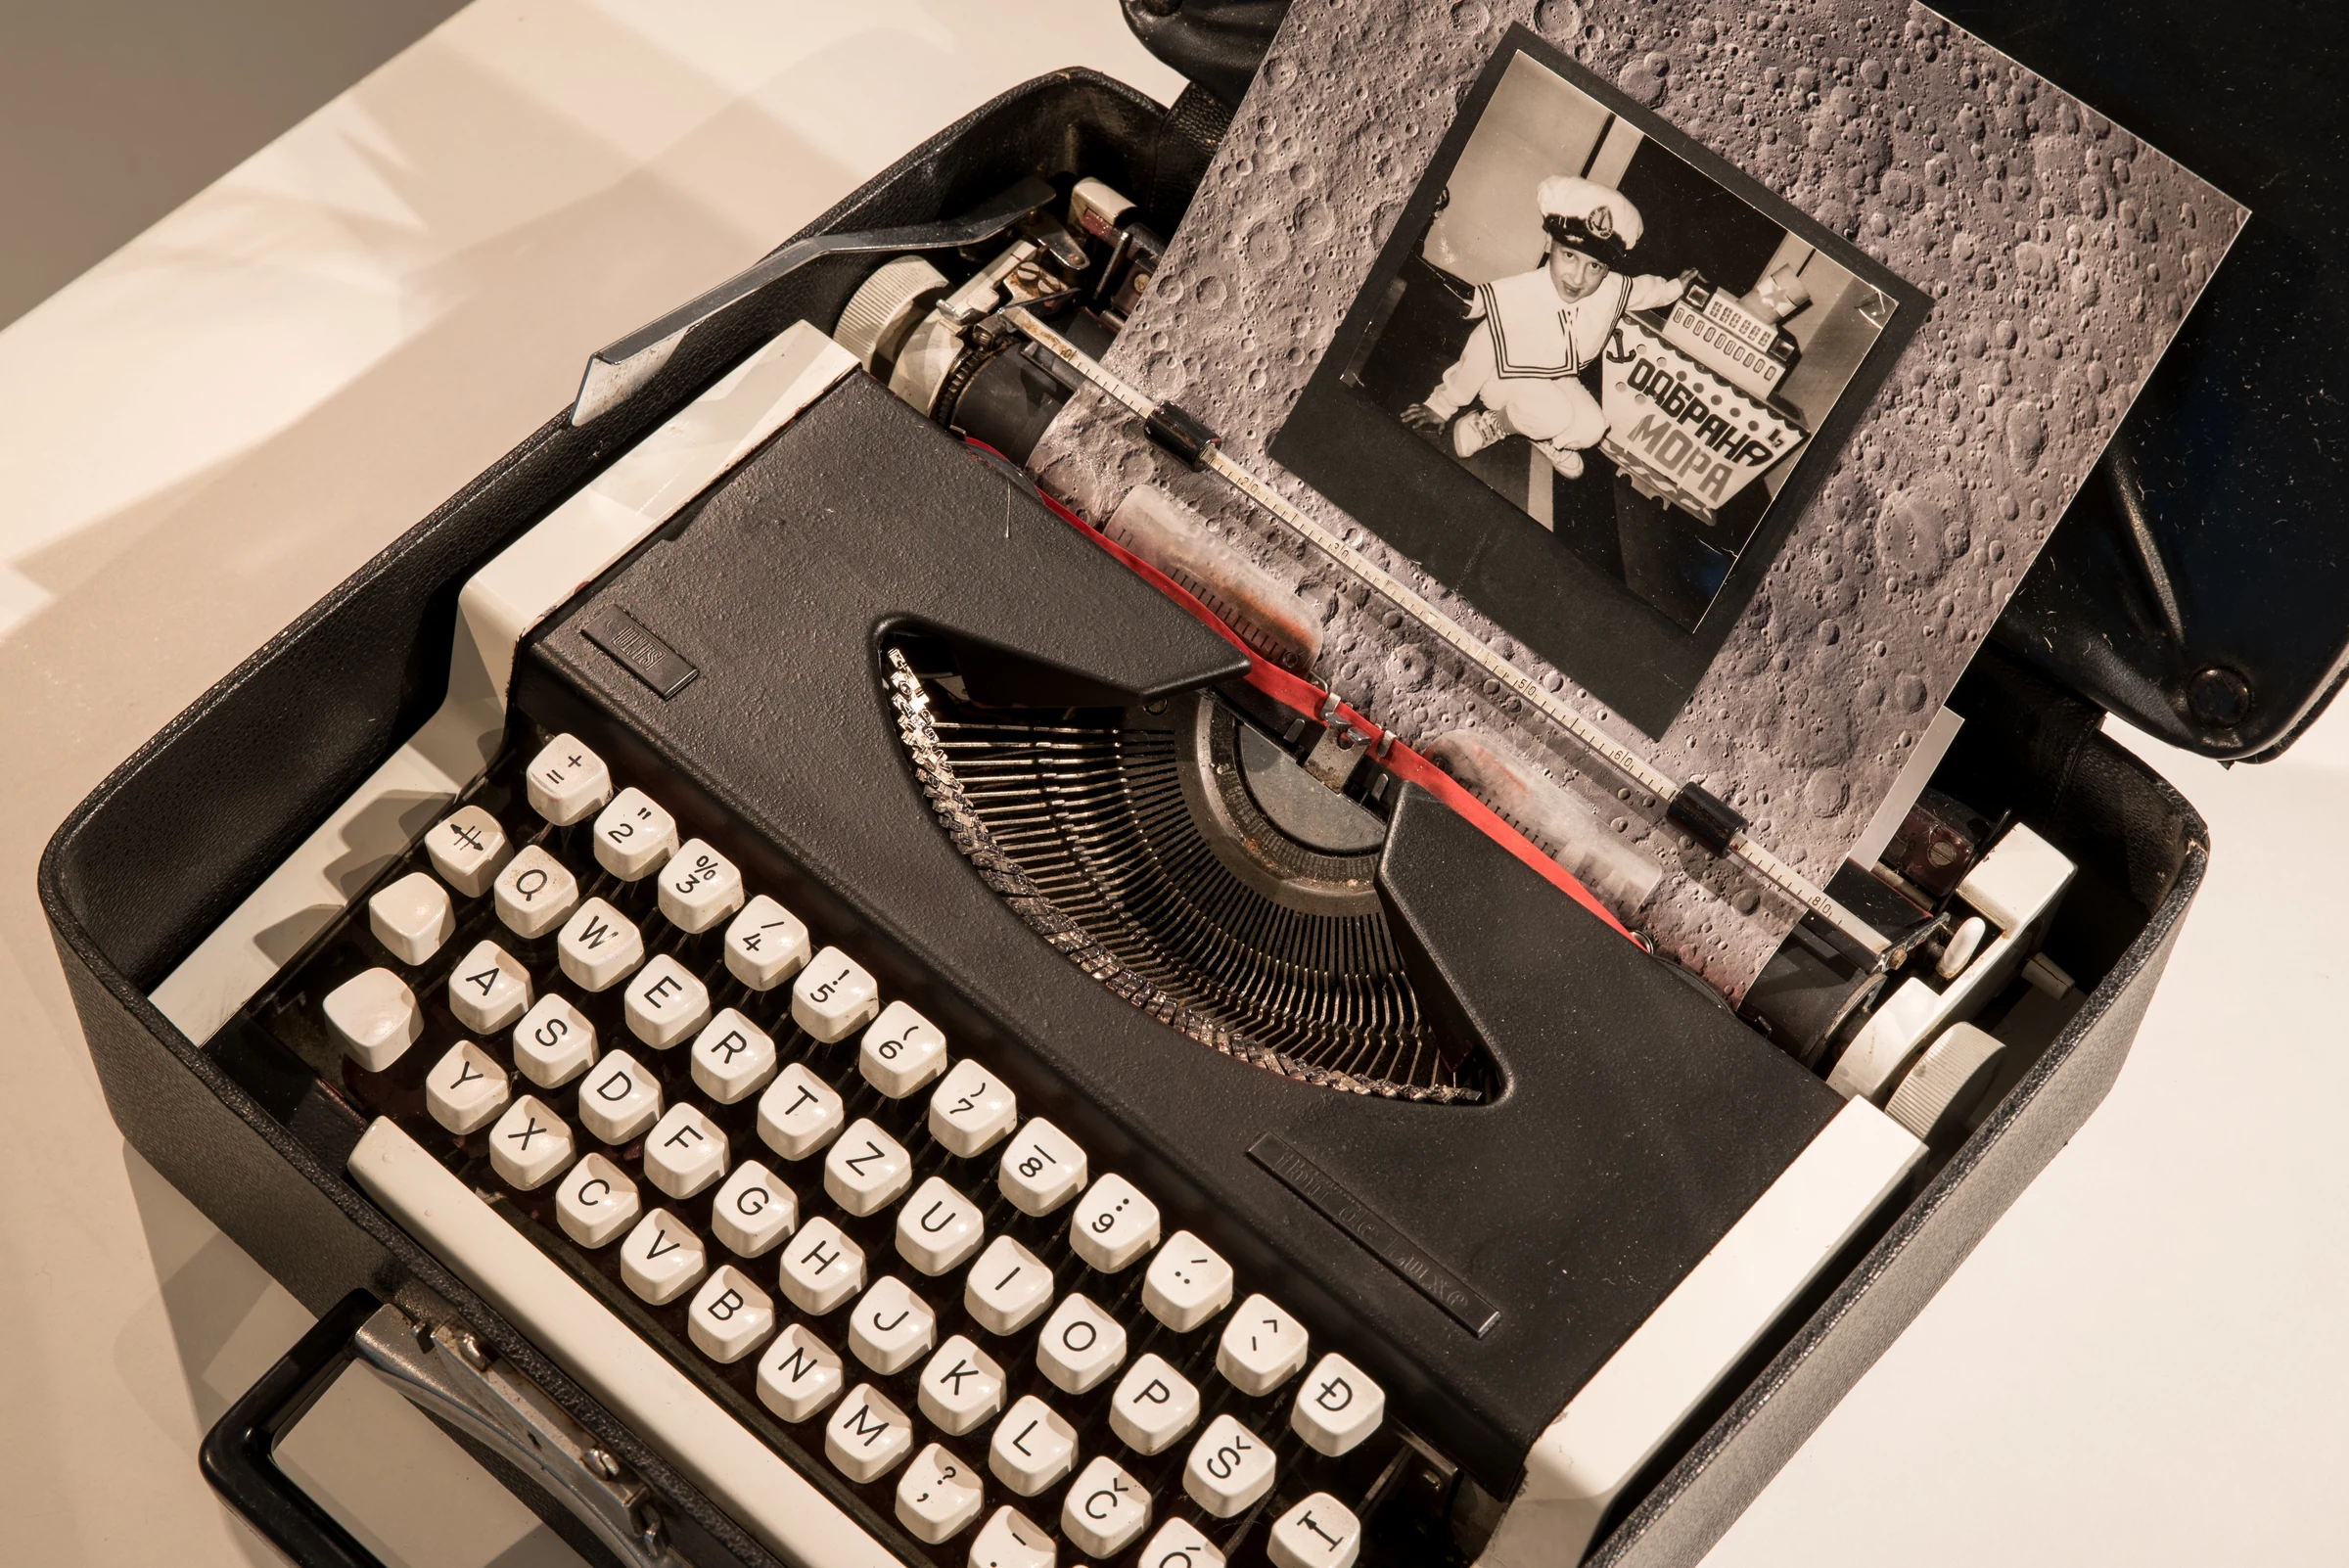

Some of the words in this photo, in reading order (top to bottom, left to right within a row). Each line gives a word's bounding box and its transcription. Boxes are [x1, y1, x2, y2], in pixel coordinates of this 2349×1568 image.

[1627, 357, 1774, 467] ОДБРАНА
[1627, 413, 1734, 503] МОРА
[1517, 678, 1537, 696] 50
[1613, 750, 1634, 766] 60
[1812, 896, 1832, 914] 80
[516, 868, 548, 902] Q
[578, 915, 619, 950] W
[742, 933, 761, 951] 4
[465, 967, 500, 996] A
[643, 975, 683, 1009] E
[809, 983, 836, 1003] 5
[534, 1018, 568, 1047] S
[712, 1030, 747, 1065] R
[878, 1039, 904, 1060] 6
[449, 1060, 484, 1089] Y
[597, 1070, 632, 1102] D
[784, 1084, 819, 1116] T
[948, 1097, 975, 1115] 7
[507, 1117, 547, 1151] X
[664, 1125, 704, 1149] F
[845, 1140, 886, 1176] Z
[1018, 1156, 1044, 1178] 8
[577, 1178, 611, 1206] C
[736, 1186, 769, 1216] G
[920, 1200, 956, 1232] U
[1091, 1213, 1115, 1233] 9
[646, 1228, 681, 1260] V
[801, 1240, 841, 1275] H
[994, 1267, 1021, 1291] I
[707, 1287, 744, 1321] B
[873, 1310, 909, 1331] J
[1062, 1320, 1097, 1352] O
[777, 1346, 818, 1383] N
[940, 1359, 980, 1396] K
[1132, 1378, 1171, 1405] P
[843, 1404, 890, 1447] M
[1012, 1419, 1038, 1456] L
[1206, 1435, 1253, 1479] Š
[1084, 1476, 1128, 1520] Č
